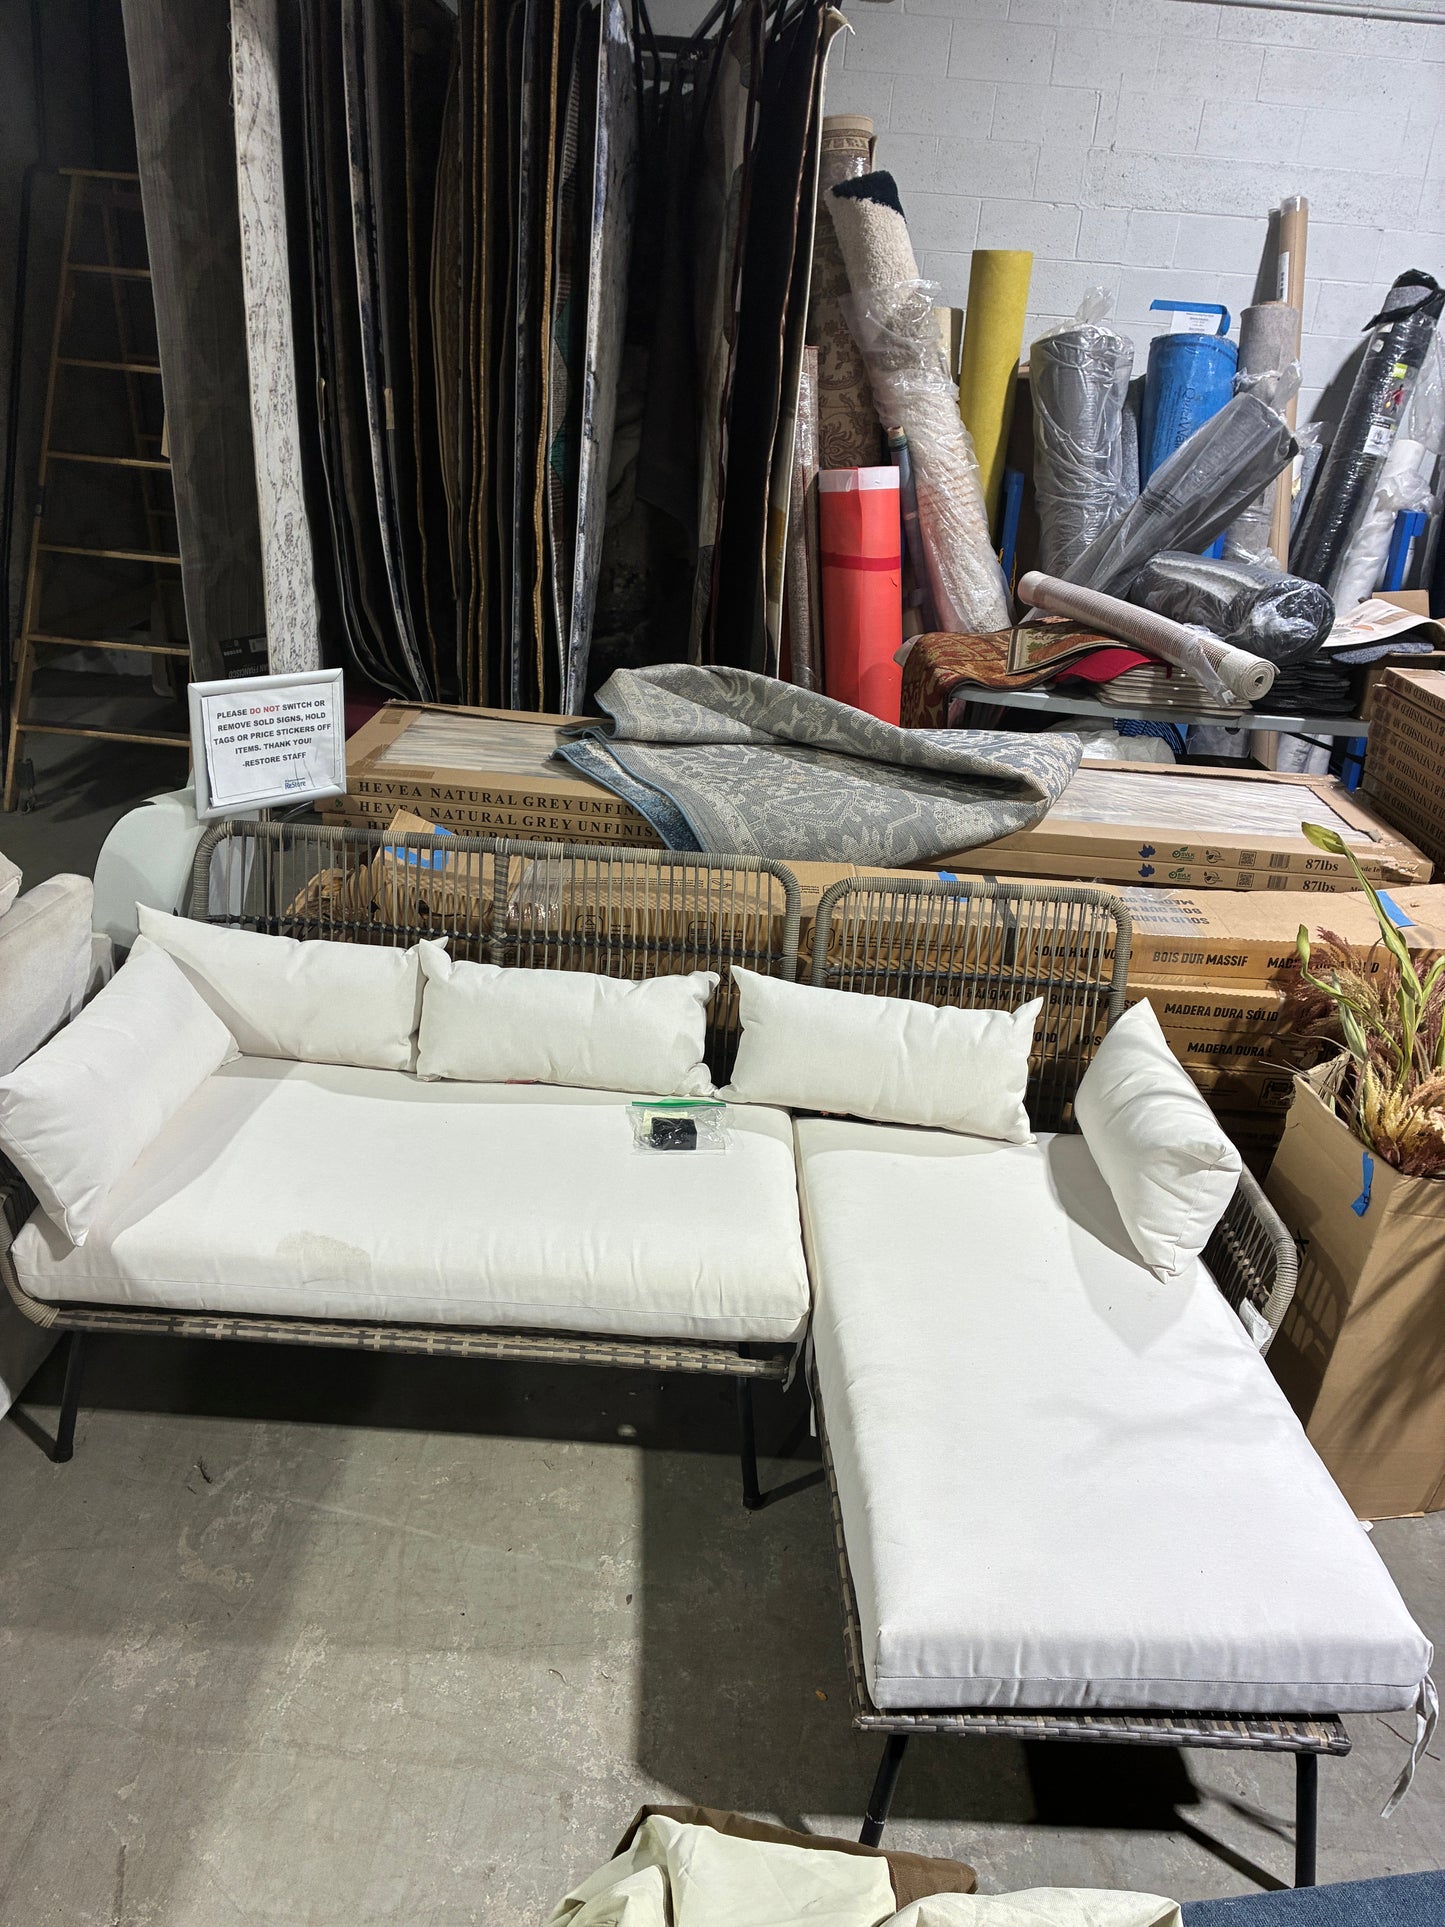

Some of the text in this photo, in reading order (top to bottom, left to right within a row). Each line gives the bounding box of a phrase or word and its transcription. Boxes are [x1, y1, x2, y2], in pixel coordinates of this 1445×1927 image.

[217, 699, 325, 719] PLEASE DO NOT SWITCH OR
[217, 712, 326, 732] REMOVE SOLD SIGNS, HOLD
[213, 723, 332, 745] TAGS OR PRICE STICKERS OFF
[235, 737, 312, 755] ITEMS. THANK YOU!
[242, 752, 307, 768] -RESTORE STAFF
[359, 781, 642, 816] HEVEA NATURAL GREY UNFIN
[430, 807, 518, 826] NATURAL
[522, 815, 573, 831] GREY
[578, 820, 660, 838] UNFINIS
[1305, 858, 1339, 872] 87lbs
[1302, 880, 1336, 893] 87lbs
[1170, 916, 1210, 925] SOLID
[1152, 951, 1179, 963] BOIS
[1181, 953, 1204, 965] DUR
[1205, 954, 1249, 967] MASSIF
[1164, 1003, 1211, 1016] MADERA
[1213, 1006, 1244, 1018] DURA
[1187, 1042, 1233, 1055] MADERA
[1235, 1045, 1265, 1057] DURA
